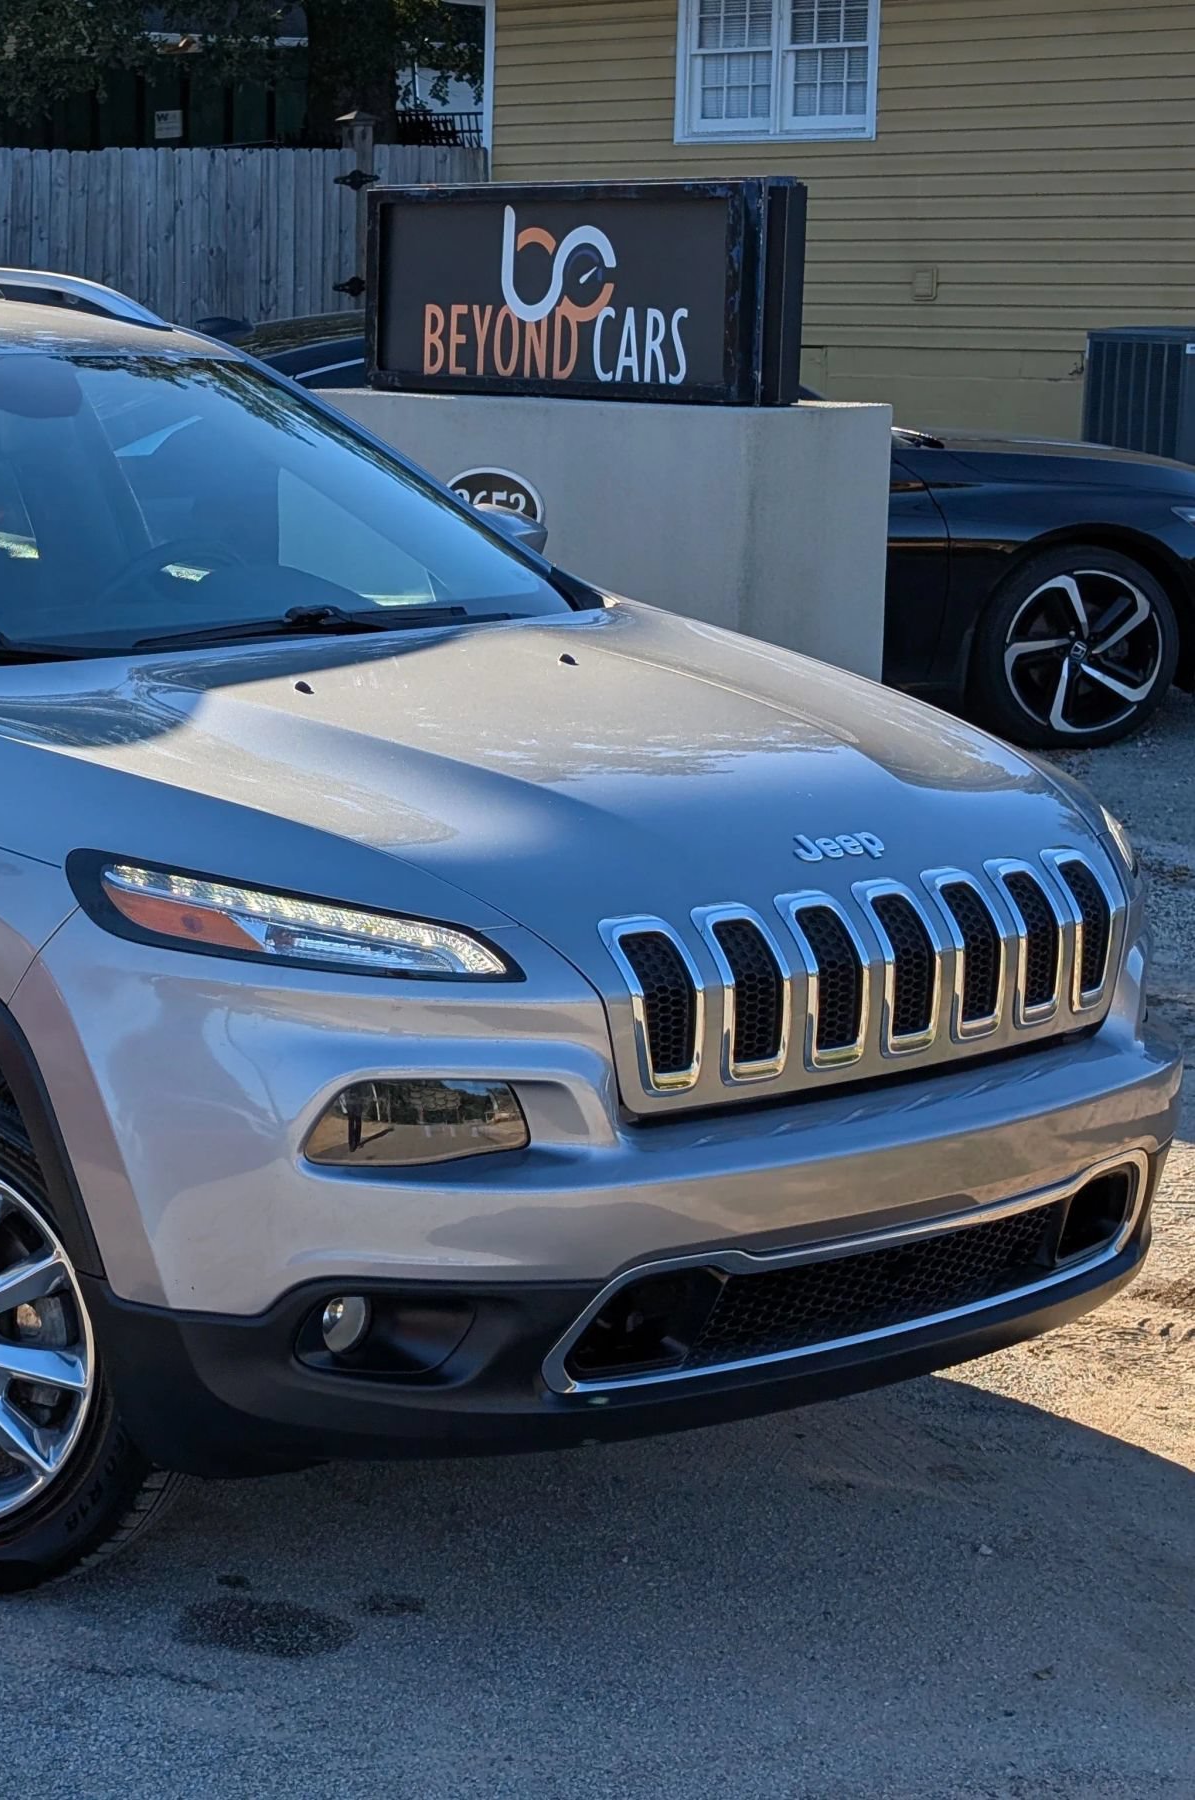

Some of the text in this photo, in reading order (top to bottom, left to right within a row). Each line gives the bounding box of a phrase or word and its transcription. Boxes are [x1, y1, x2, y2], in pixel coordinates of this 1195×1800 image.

[423, 303, 689, 385] BEYOND CARS
[792, 831, 885, 862] Jeep
